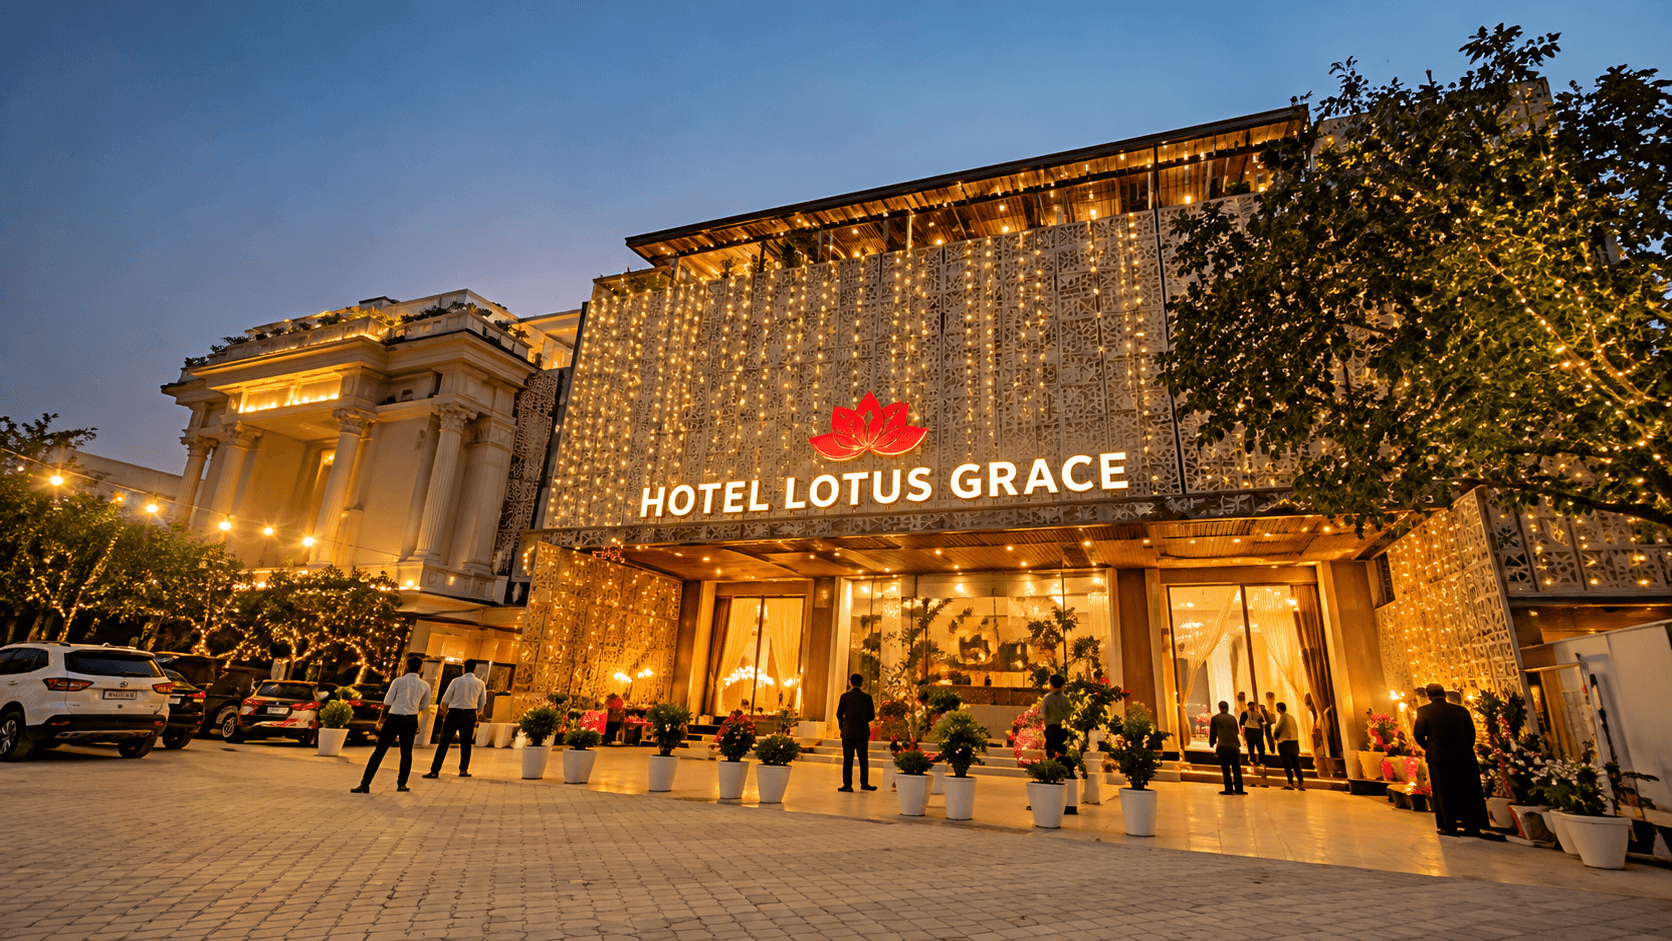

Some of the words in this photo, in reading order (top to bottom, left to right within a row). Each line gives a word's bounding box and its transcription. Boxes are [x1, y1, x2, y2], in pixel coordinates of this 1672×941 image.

[639, 480, 770, 518] HOTEL
[784, 467, 932, 510] LOTUS
[950, 452, 1129, 499] GRACE
